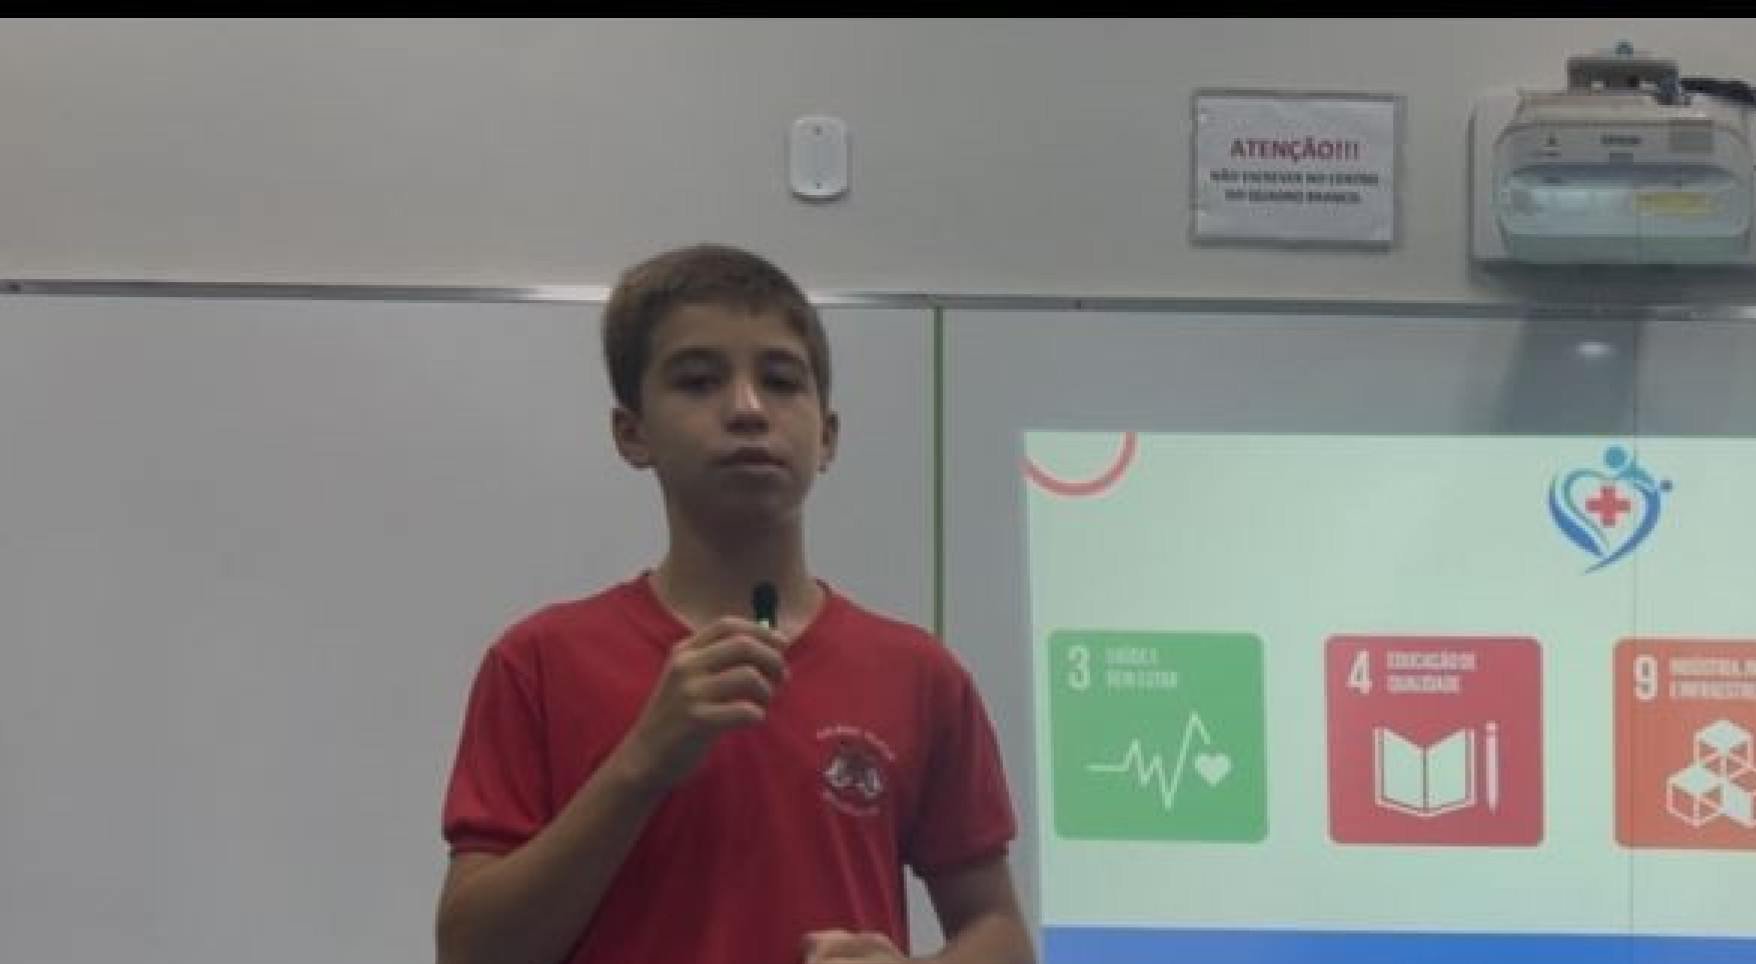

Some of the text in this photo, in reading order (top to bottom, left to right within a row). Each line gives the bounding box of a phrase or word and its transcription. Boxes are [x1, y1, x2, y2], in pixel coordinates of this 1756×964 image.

[1230, 135, 1360, 163] ATENÇÃO!!!
[1068, 644, 1091, 691] 3
[1346, 648, 1373, 695] 4
[1634, 655, 1658, 702] 9
